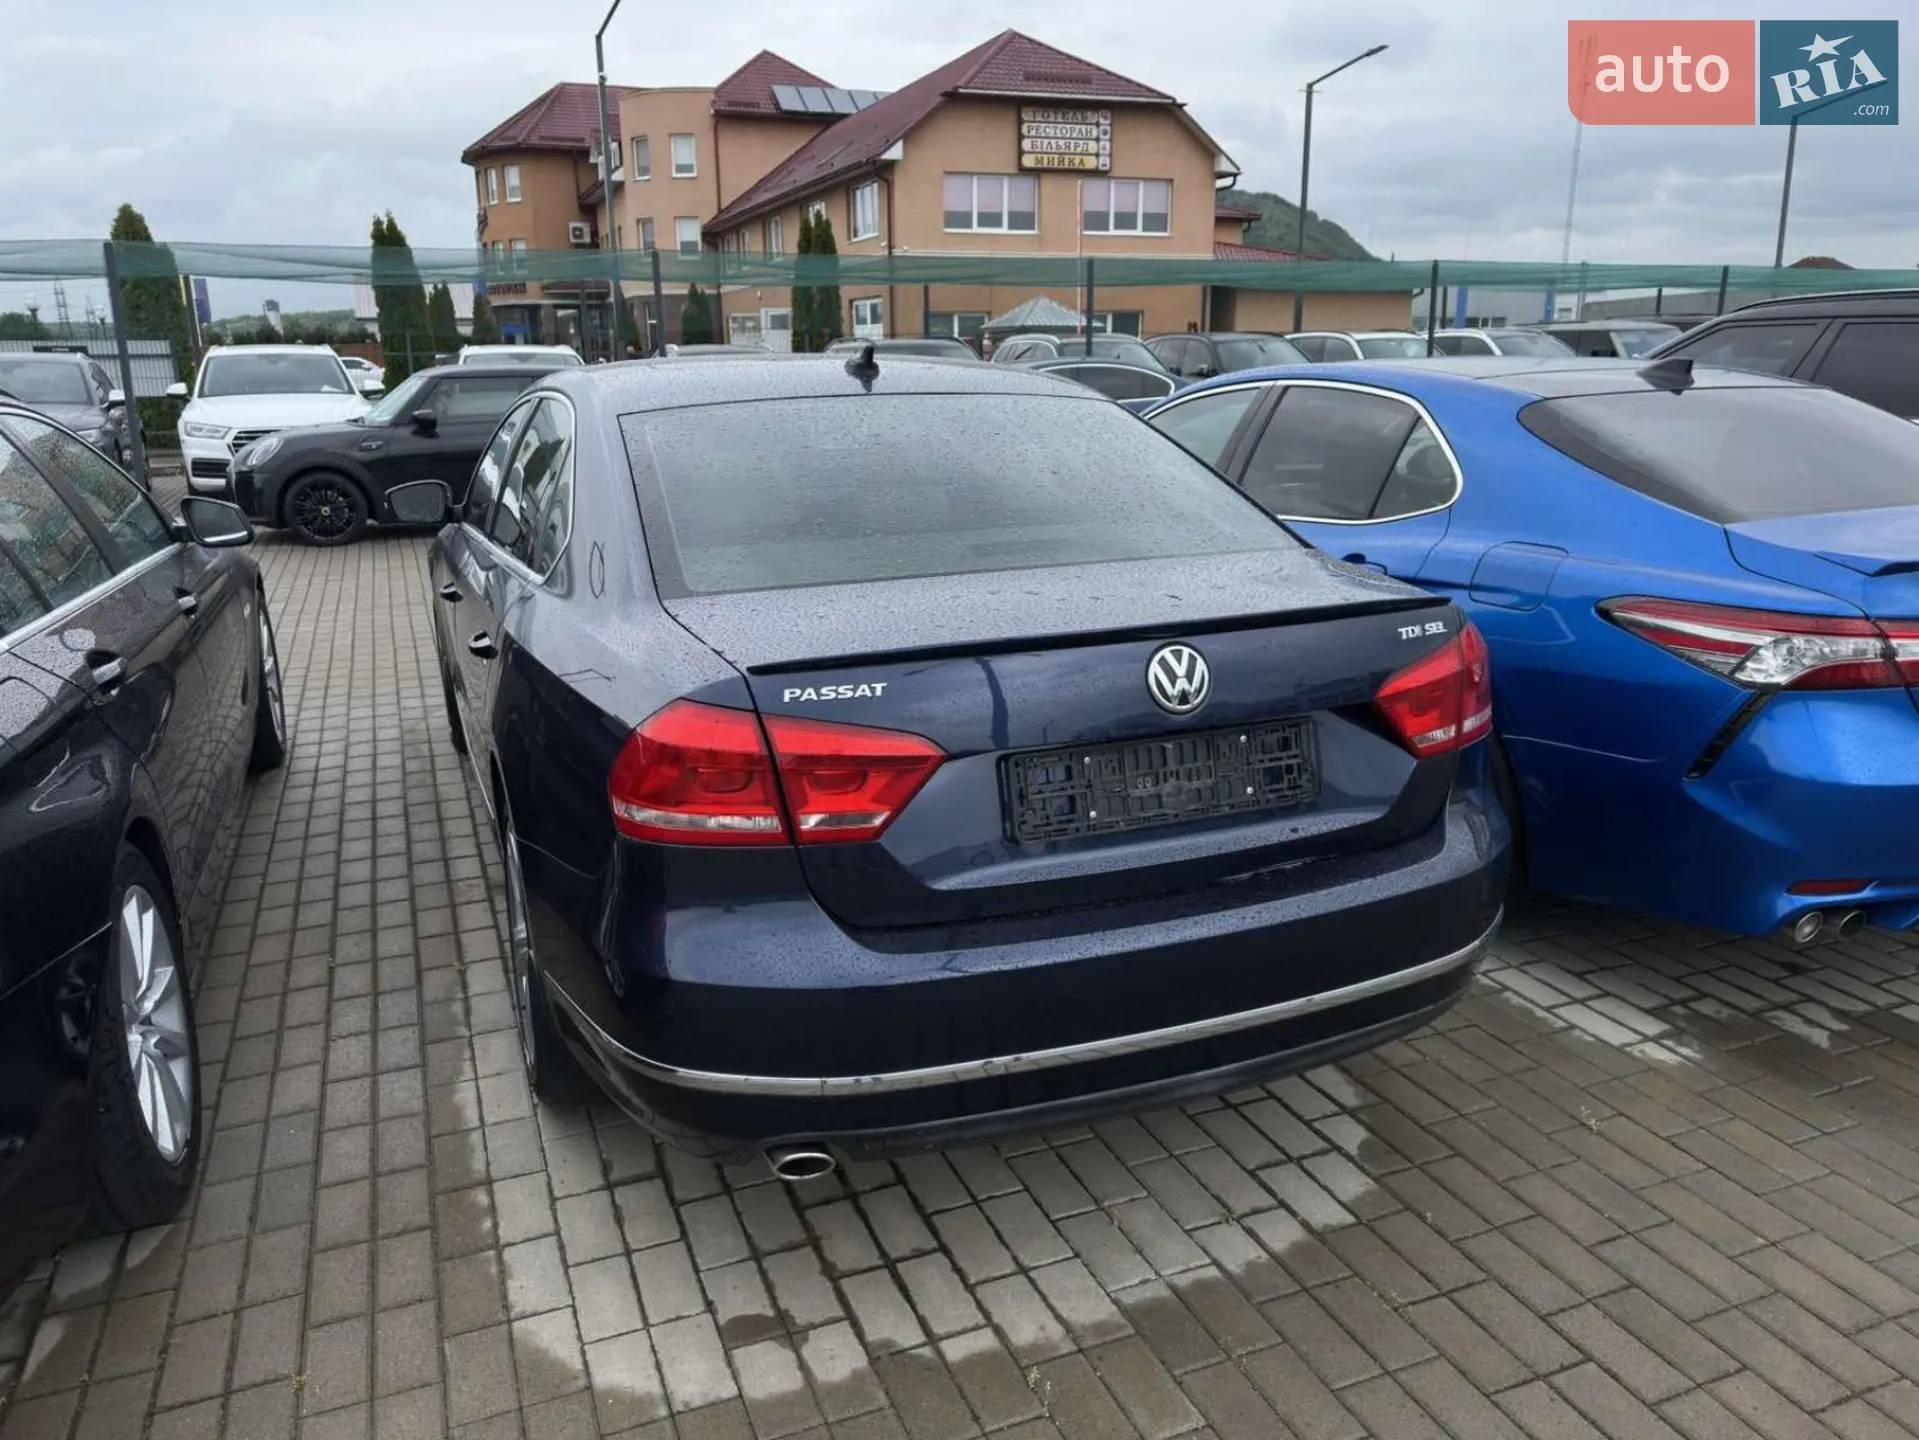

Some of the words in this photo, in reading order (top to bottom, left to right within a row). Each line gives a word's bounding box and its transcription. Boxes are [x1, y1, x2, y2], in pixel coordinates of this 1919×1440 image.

[1027, 125, 1094, 137] РЕСТОРАН
[1030, 140, 1090, 152] БІЛЬЯРД
[1424, 621, 1448, 636] SEL
[783, 682, 887, 702] PASSAT
